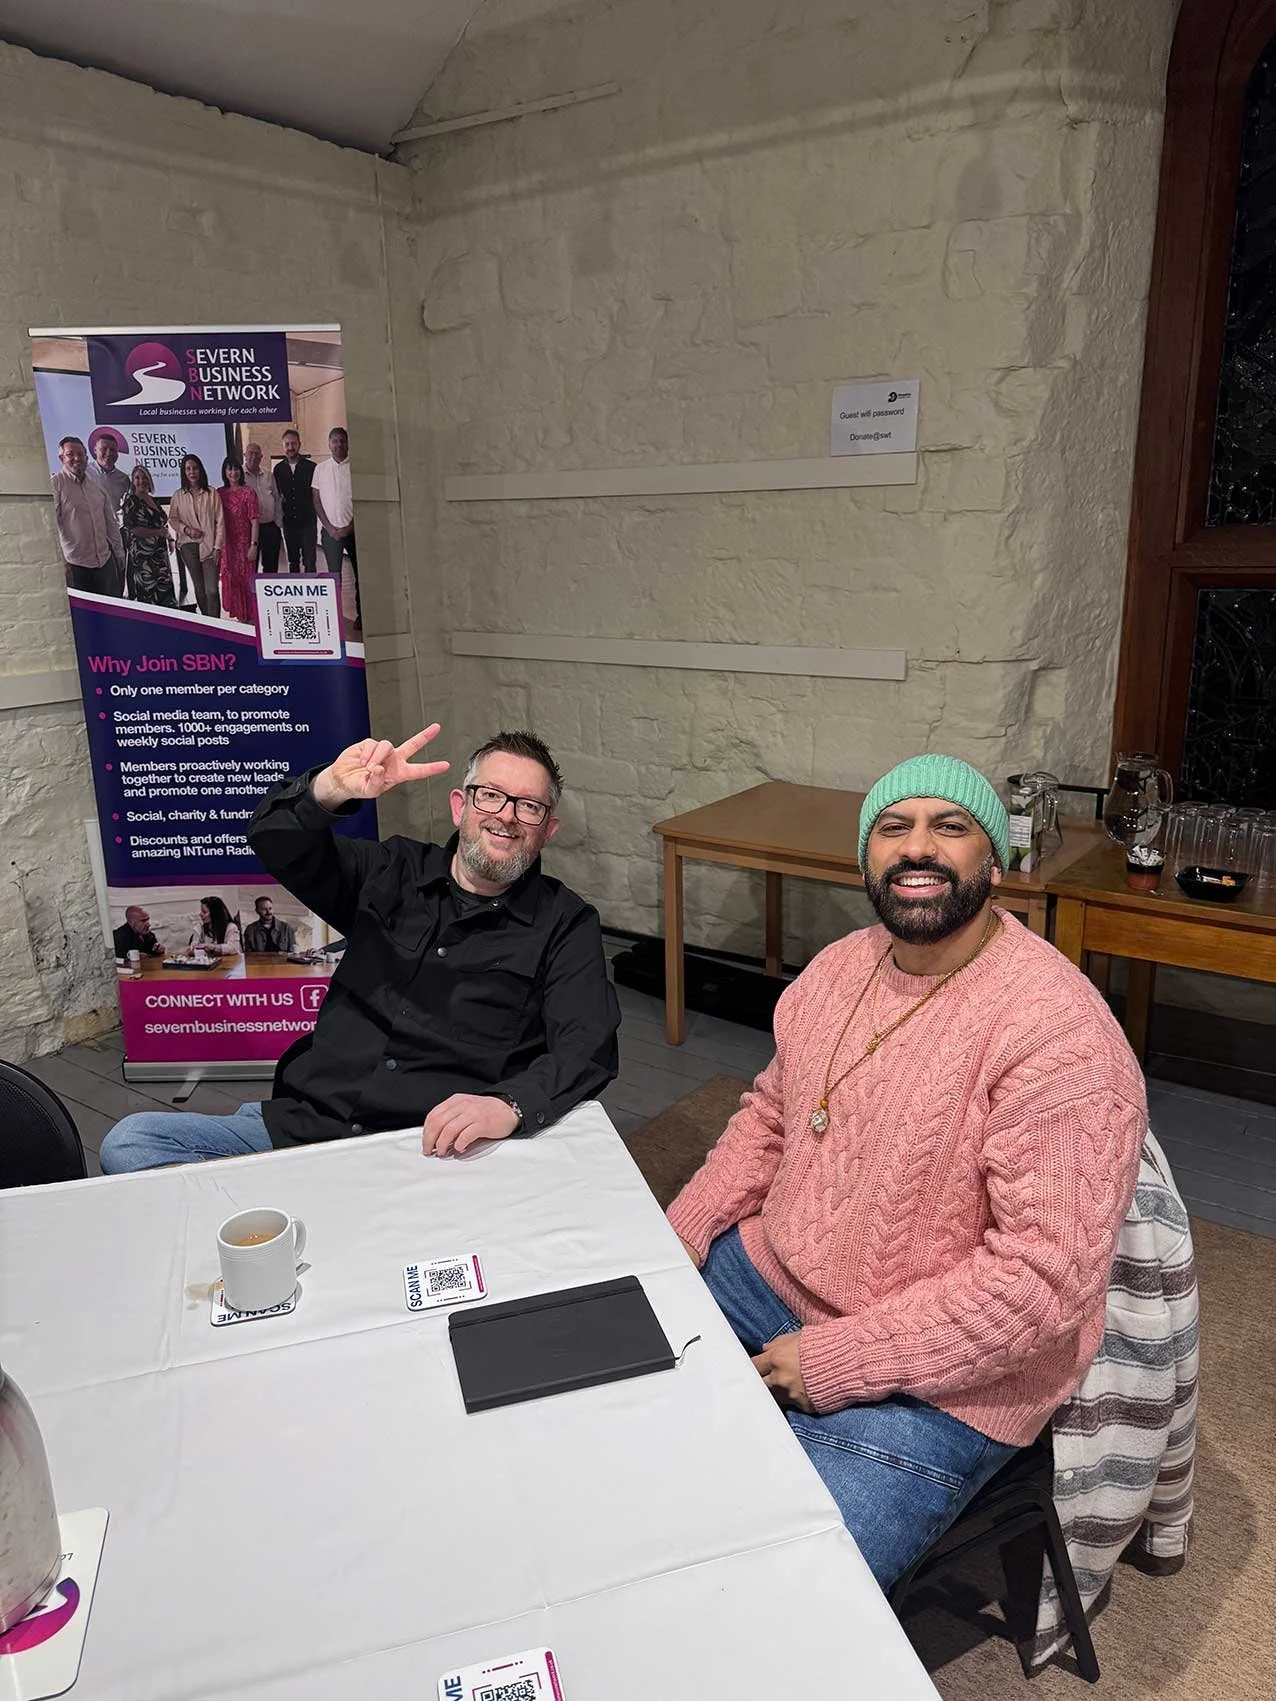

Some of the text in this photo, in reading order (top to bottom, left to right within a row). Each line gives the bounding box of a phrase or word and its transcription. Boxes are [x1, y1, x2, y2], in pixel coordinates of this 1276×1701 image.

[186, 348, 255, 365] SEVERN
[188, 366, 272, 383] BUSINESS
[190, 384, 281, 401] NETWORK
[139, 408, 158, 416] Local
[198, 407, 226, 415] working
[228, 406, 239, 415] for
[240, 406, 257, 414] each
[258, 406, 278, 414] other
[839, 408, 905, 420] Guest wifi password
[131, 432, 177, 444] SEVERN
[133, 445, 188, 457] BUSINESS
[263, 585, 329, 597] SCAN ME
[88, 653, 237, 676] Why Join SBN?
[110, 683, 290, 698] Only one member per category
[113, 709, 290, 722] Social media team, to promote
[115, 722, 310, 735] members. 1000+ engagements on
[117, 735, 230, 749] weekly social posts
[120, 760, 290, 773] Members proactively working
[122, 771, 285, 787] together to create new leads
[123, 784, 269, 799] and promote one another
[126, 808, 255, 823] Social, charity & fundr
[130, 833, 248, 847] Discounts and offers
[131, 847, 182, 859] amazing
[183, 846, 224, 857] INTune
[145, 993, 224, 1008] CONNECT
[226, 993, 268, 1007] WITH
[271, 992, 294, 1006] US
[406, 1265, 423, 1308] SCAN ME
[216, 1311, 241, 1323] ME
